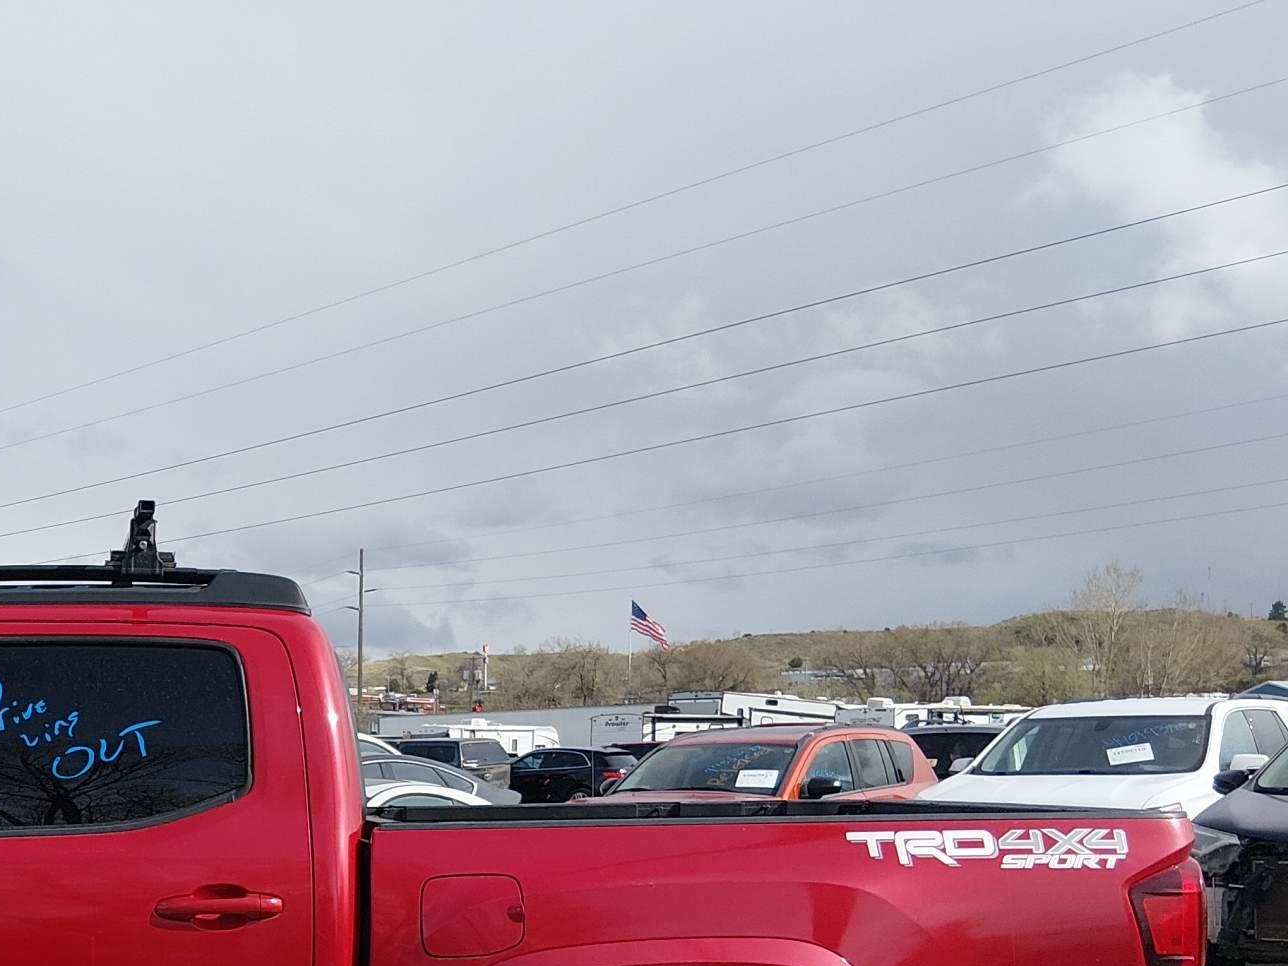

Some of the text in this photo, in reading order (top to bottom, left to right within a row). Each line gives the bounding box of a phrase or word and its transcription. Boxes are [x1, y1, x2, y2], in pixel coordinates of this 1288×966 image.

[52, 720, 161, 779] OUT
[845, 829, 999, 867] TRD
[1000, 854, 1126, 870] SPORT
